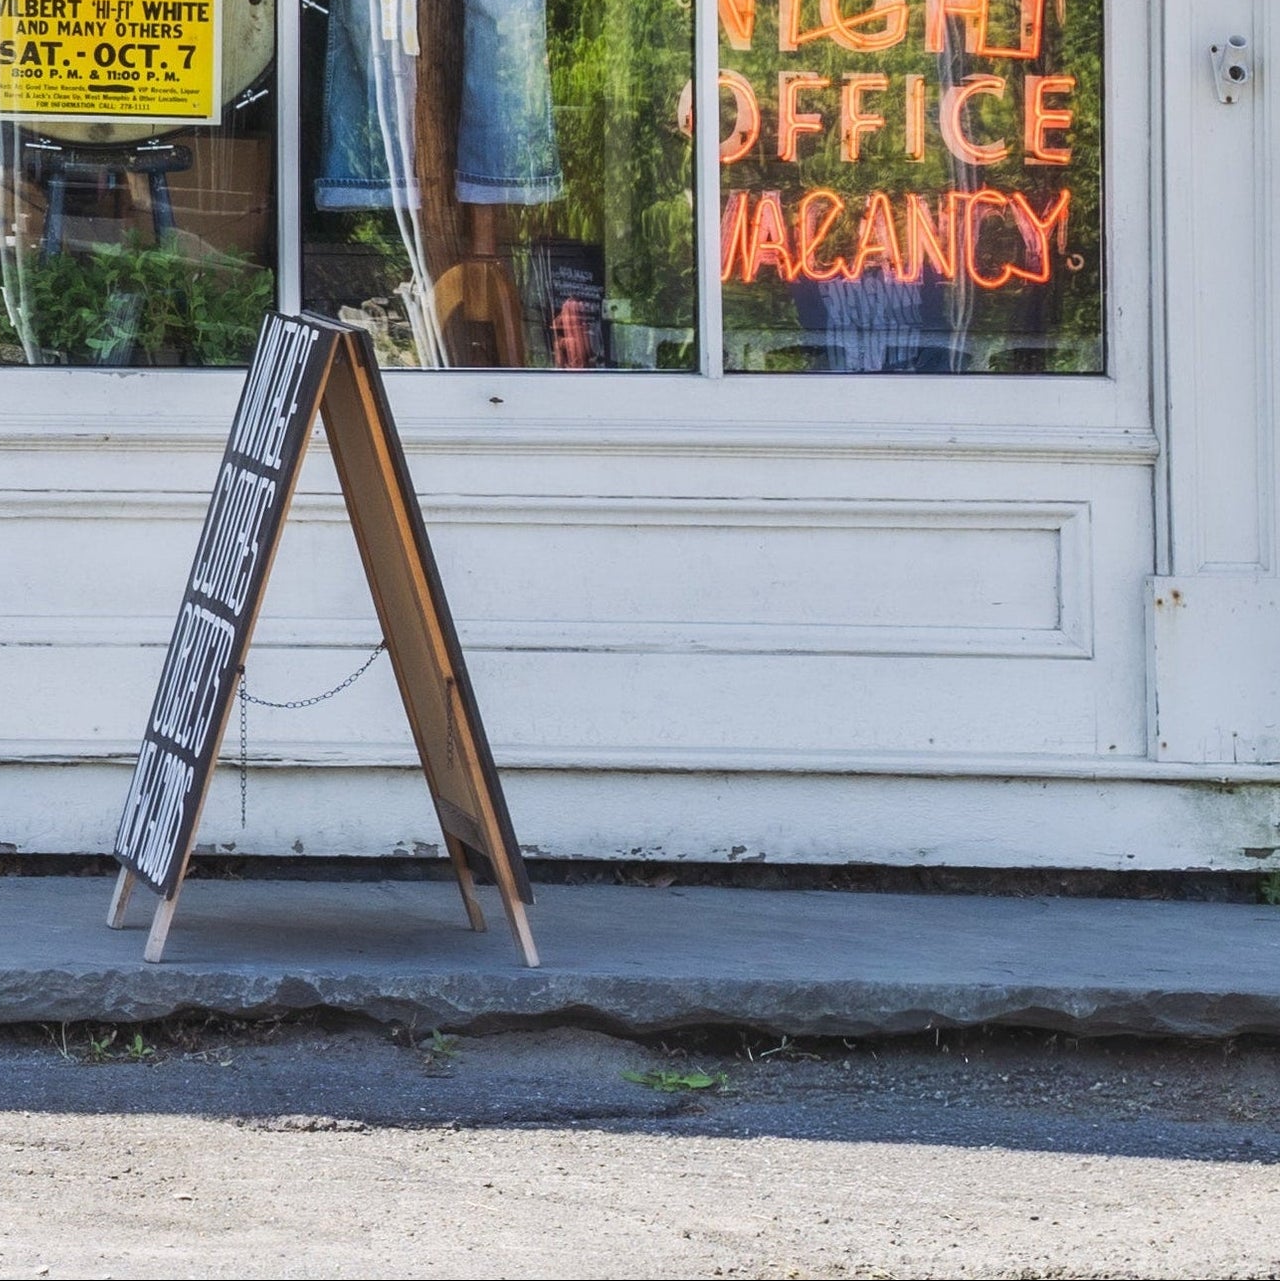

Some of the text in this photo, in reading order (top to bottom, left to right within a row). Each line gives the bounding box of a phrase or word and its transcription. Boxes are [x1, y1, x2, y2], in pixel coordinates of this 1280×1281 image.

[16, 21, 183, 38] AND MANY OTHERS
[142, 1, 209, 23] WHITE
[89, 70, 100, 79] &
[107, 70, 140, 80] 11:00
[93, 43, 168, 69] OCT.
[177, 45, 197, 69] 7
[51, 101, 95, 109] INFORMATION
[677, 69, 1076, 167] OFFICE
[721, 188, 1071, 288] VACANCY
[232, 314, 319, 470] VINTAGE
[192, 462, 276, 618] CLOTHES
[153, 601, 236, 758] OBJECTS
